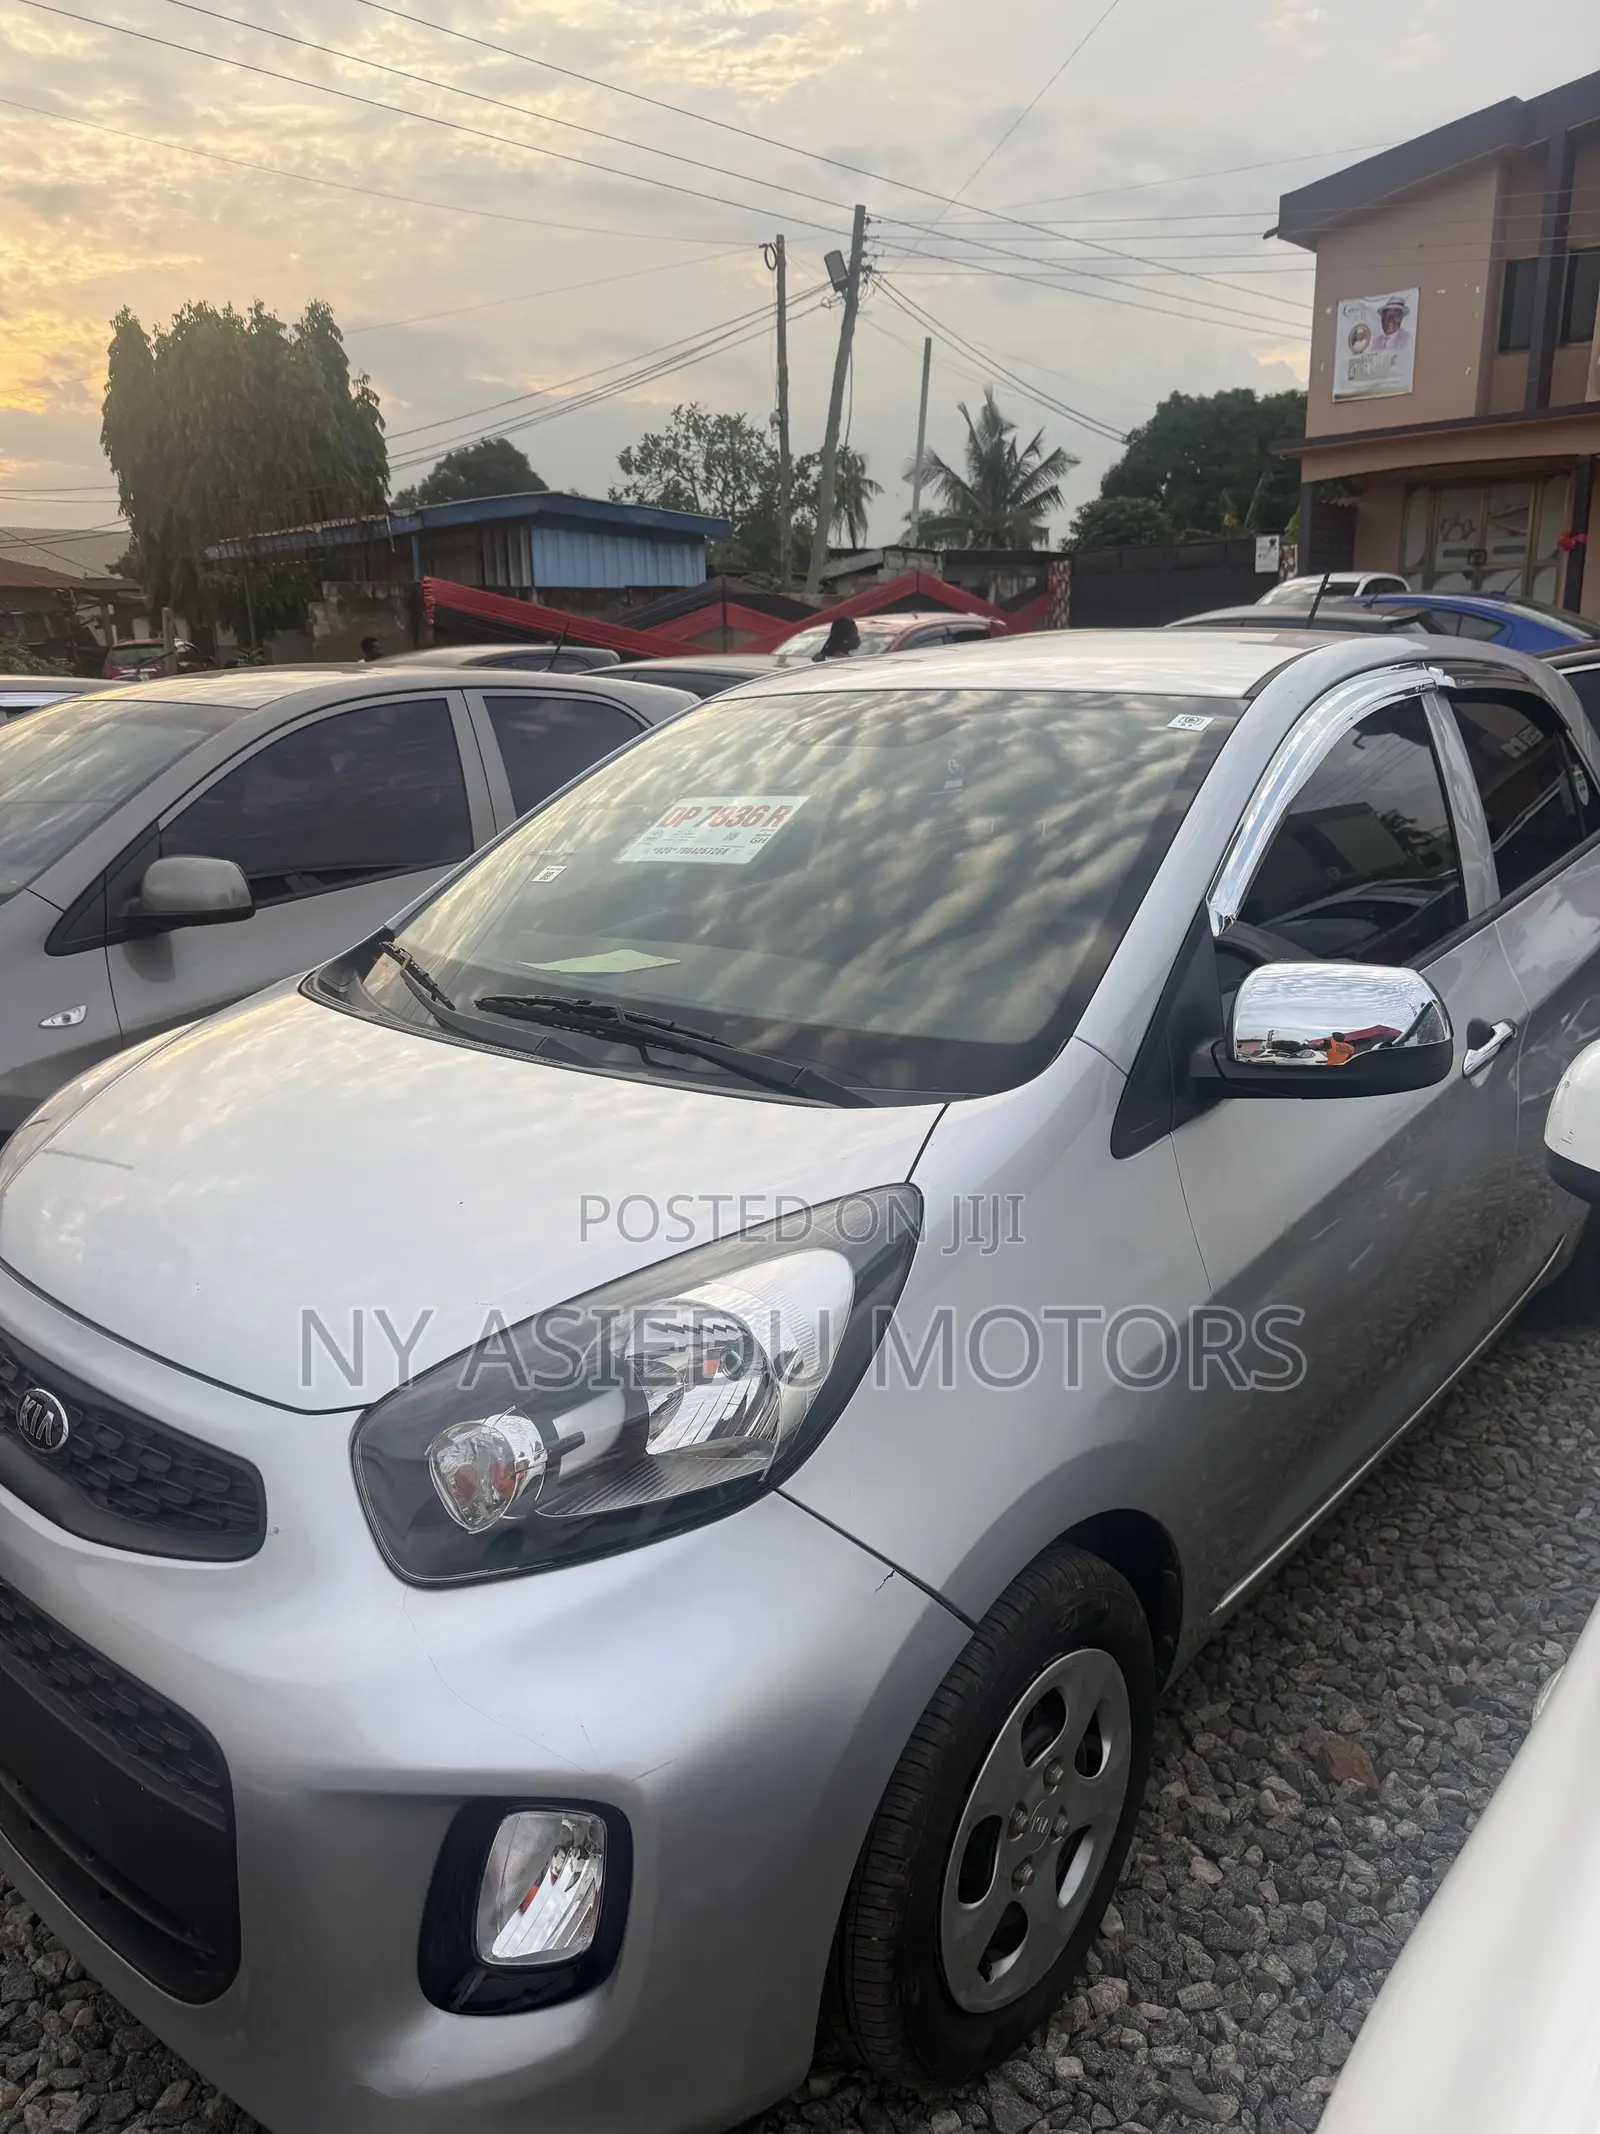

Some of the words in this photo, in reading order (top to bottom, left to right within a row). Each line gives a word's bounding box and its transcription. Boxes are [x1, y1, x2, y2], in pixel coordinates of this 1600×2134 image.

[656, 806, 703, 828] DP
[692, 805, 771, 828] 7836
[761, 805, 794, 828] R
[19, 1394, 55, 1446] KIA
